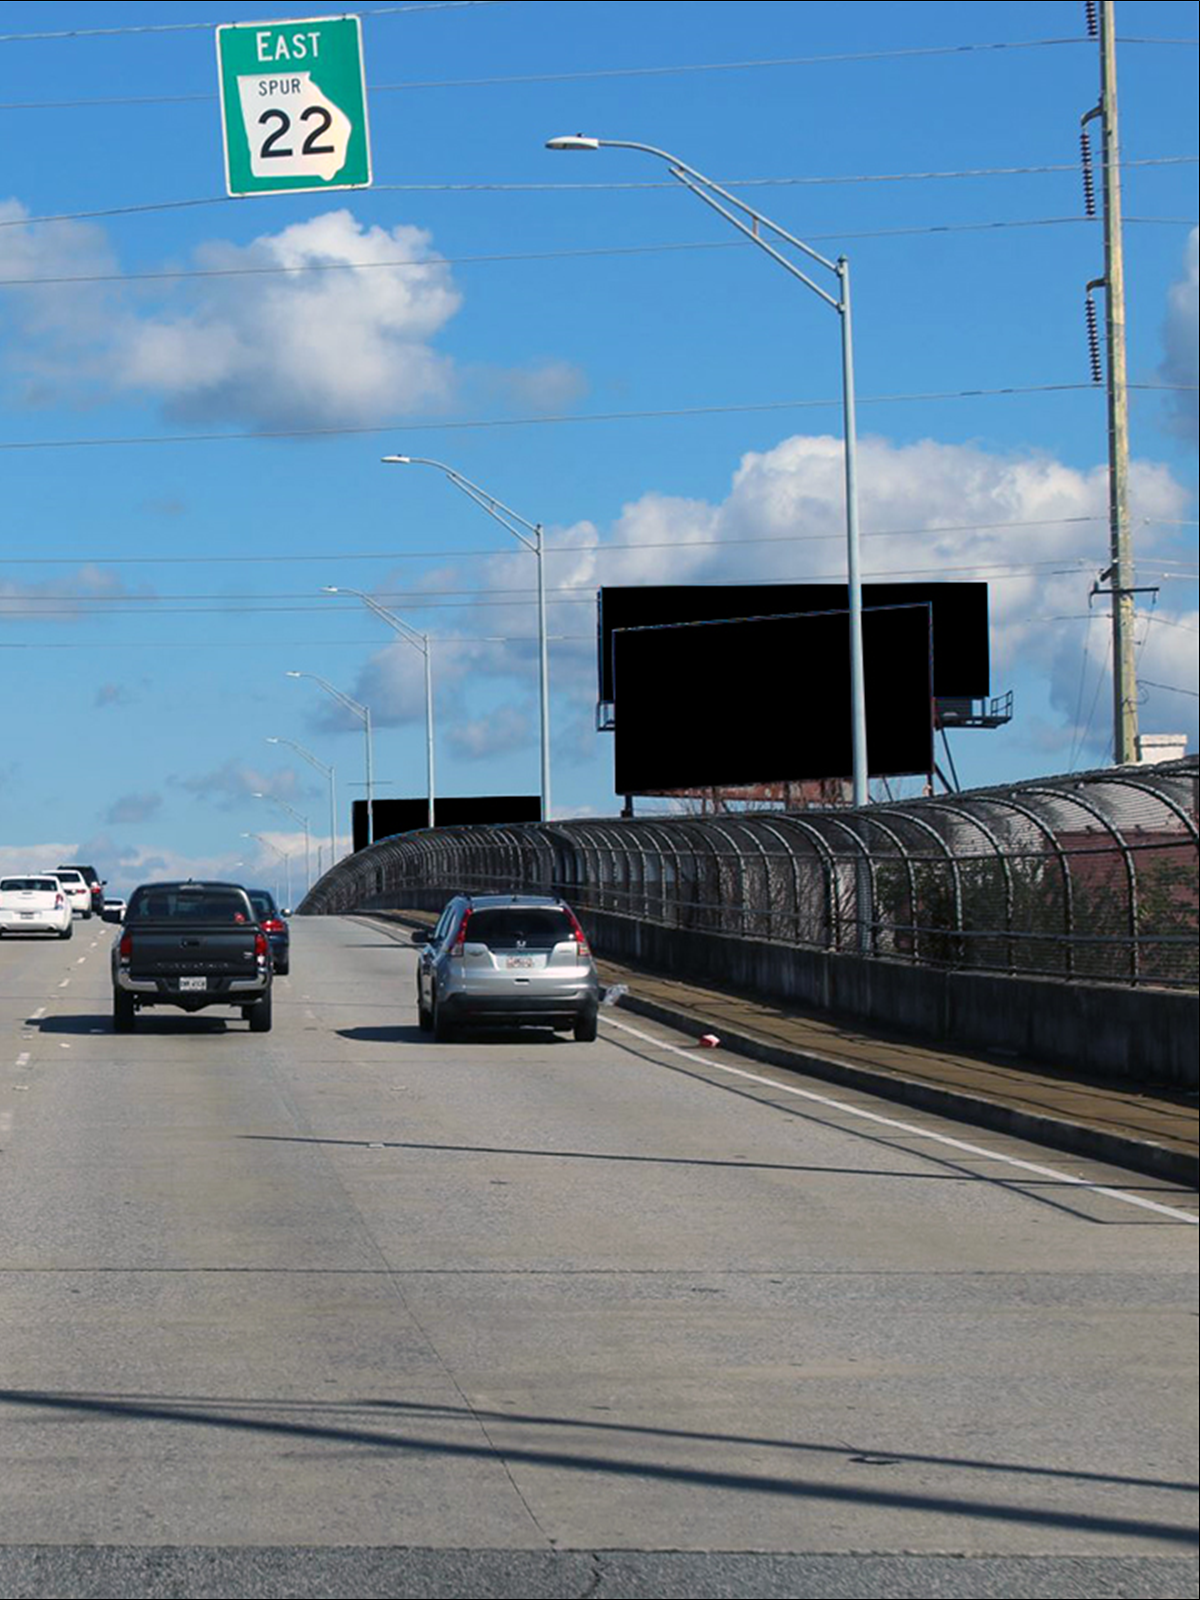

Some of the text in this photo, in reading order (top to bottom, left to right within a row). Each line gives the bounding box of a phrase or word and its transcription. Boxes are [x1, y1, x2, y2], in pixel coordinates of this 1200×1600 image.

[256, 31, 321, 62] EAST
[258, 78, 302, 96] SPUR
[258, 105, 335, 159] 22
